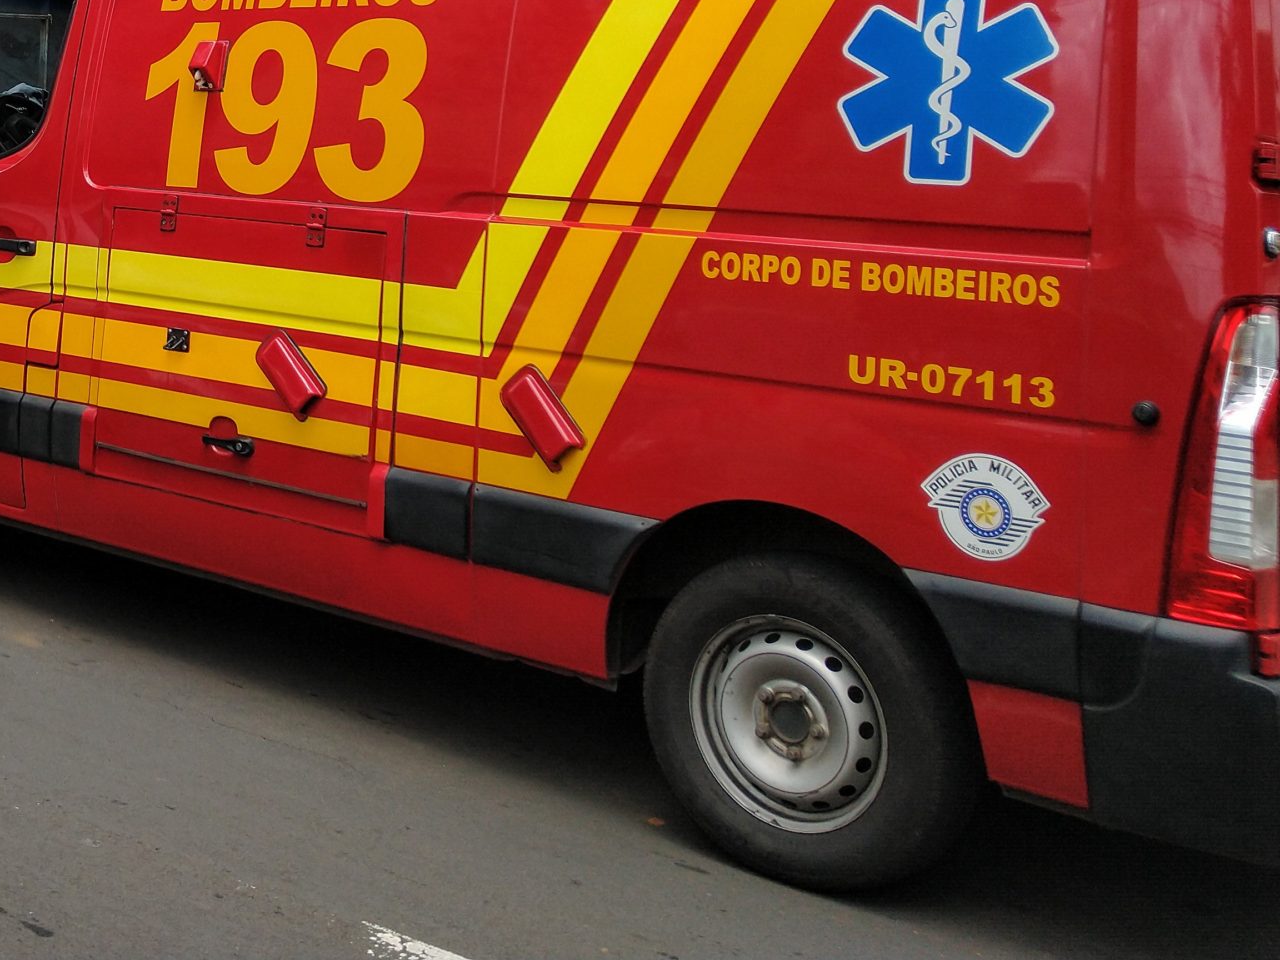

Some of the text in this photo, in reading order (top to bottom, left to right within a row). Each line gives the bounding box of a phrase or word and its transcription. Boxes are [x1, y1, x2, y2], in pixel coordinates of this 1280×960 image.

[145, 17, 428, 203] 193
[701, 249, 1061, 308] CORPO DE BOMBEIROS
[848, 354, 1057, 409] UR-07113
[988, 459, 1043, 510] MILITAR
